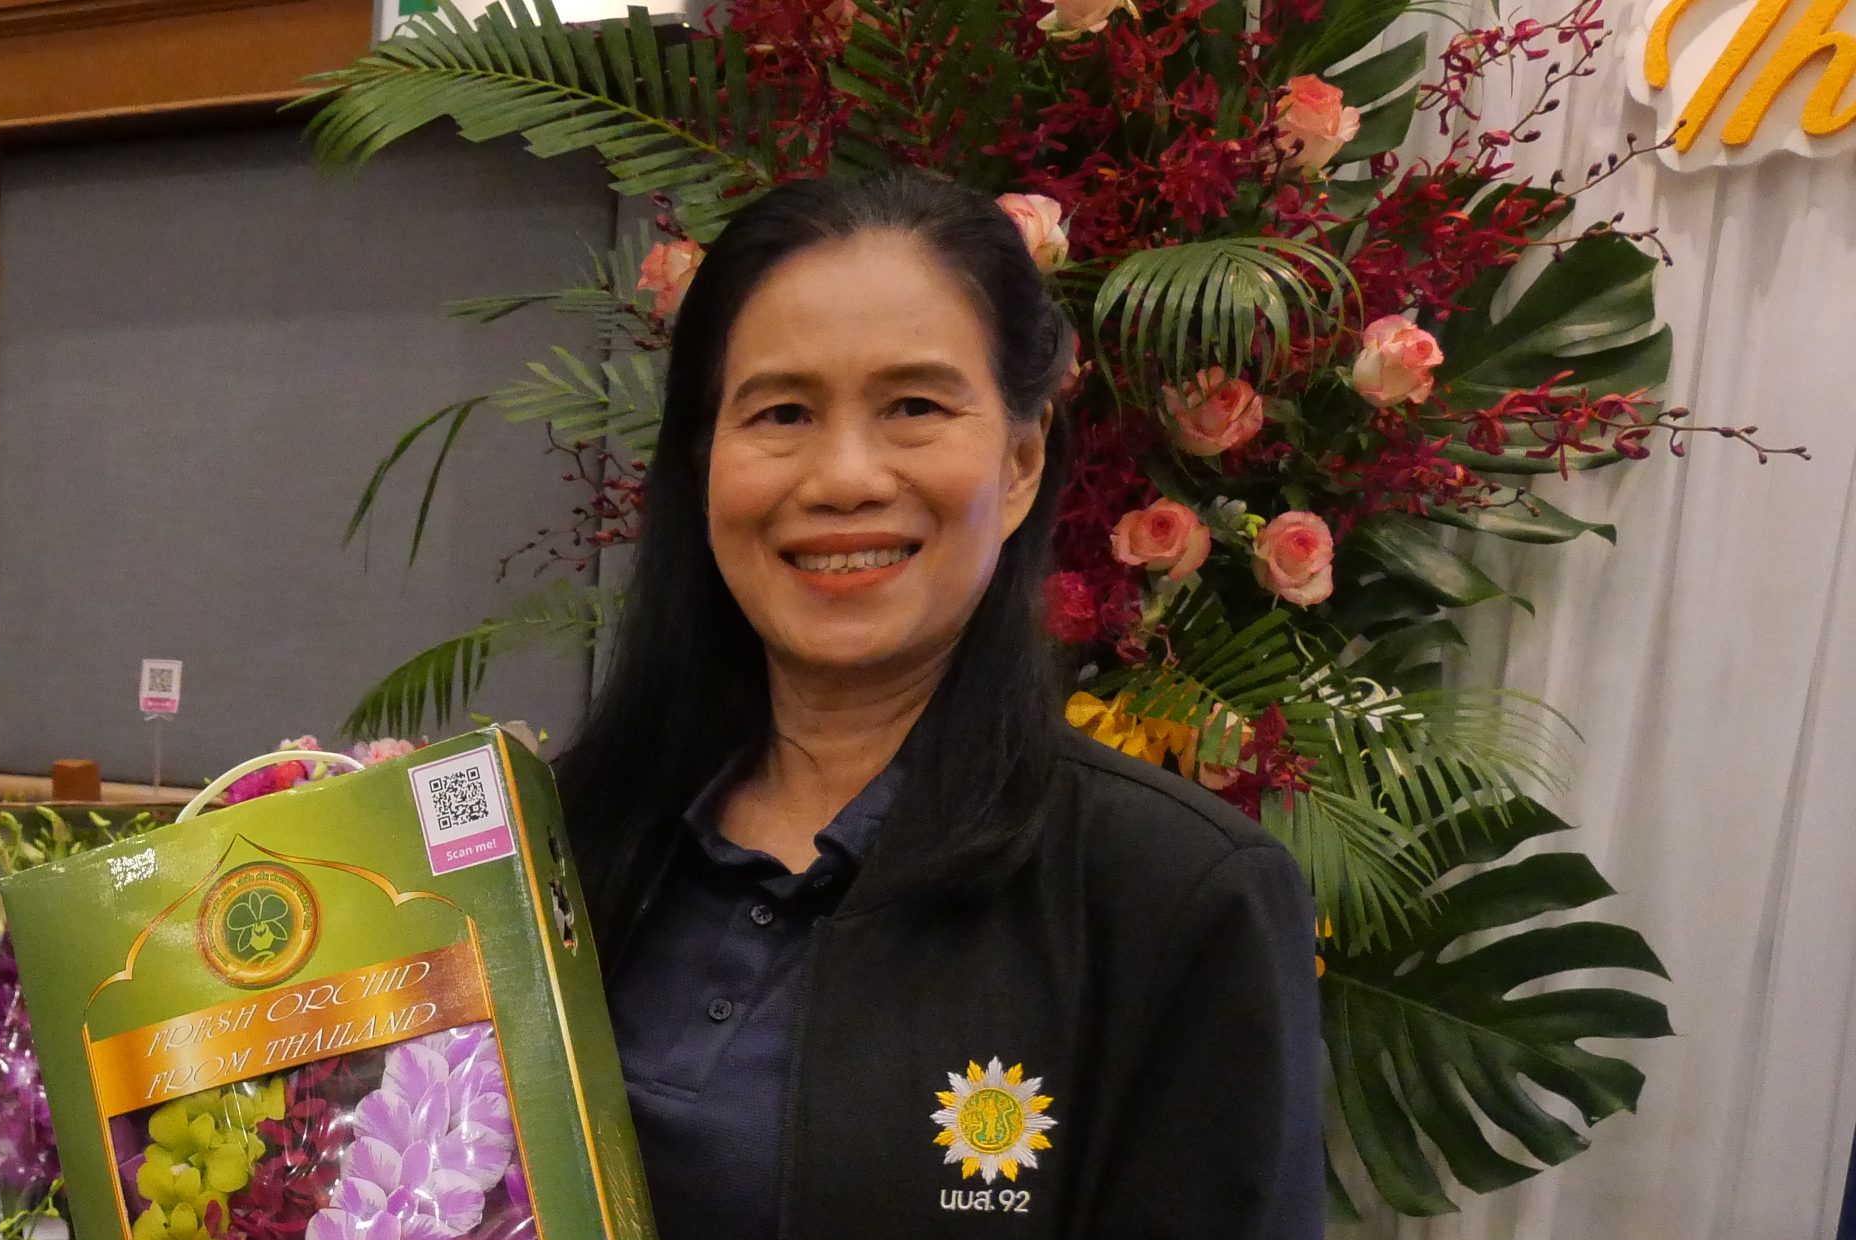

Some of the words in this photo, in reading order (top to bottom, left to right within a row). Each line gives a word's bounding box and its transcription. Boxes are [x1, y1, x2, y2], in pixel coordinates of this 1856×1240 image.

[446, 847, 473, 861] Scan
[475, 838, 497, 854] me!
[145, 1003, 258, 1058] FRESH
[266, 961, 432, 1022] ORCHID
[144, 1047, 253, 1100] FROM
[262, 1002, 437, 1066] THAILAND
[998, 1189, 1031, 1213] 92
